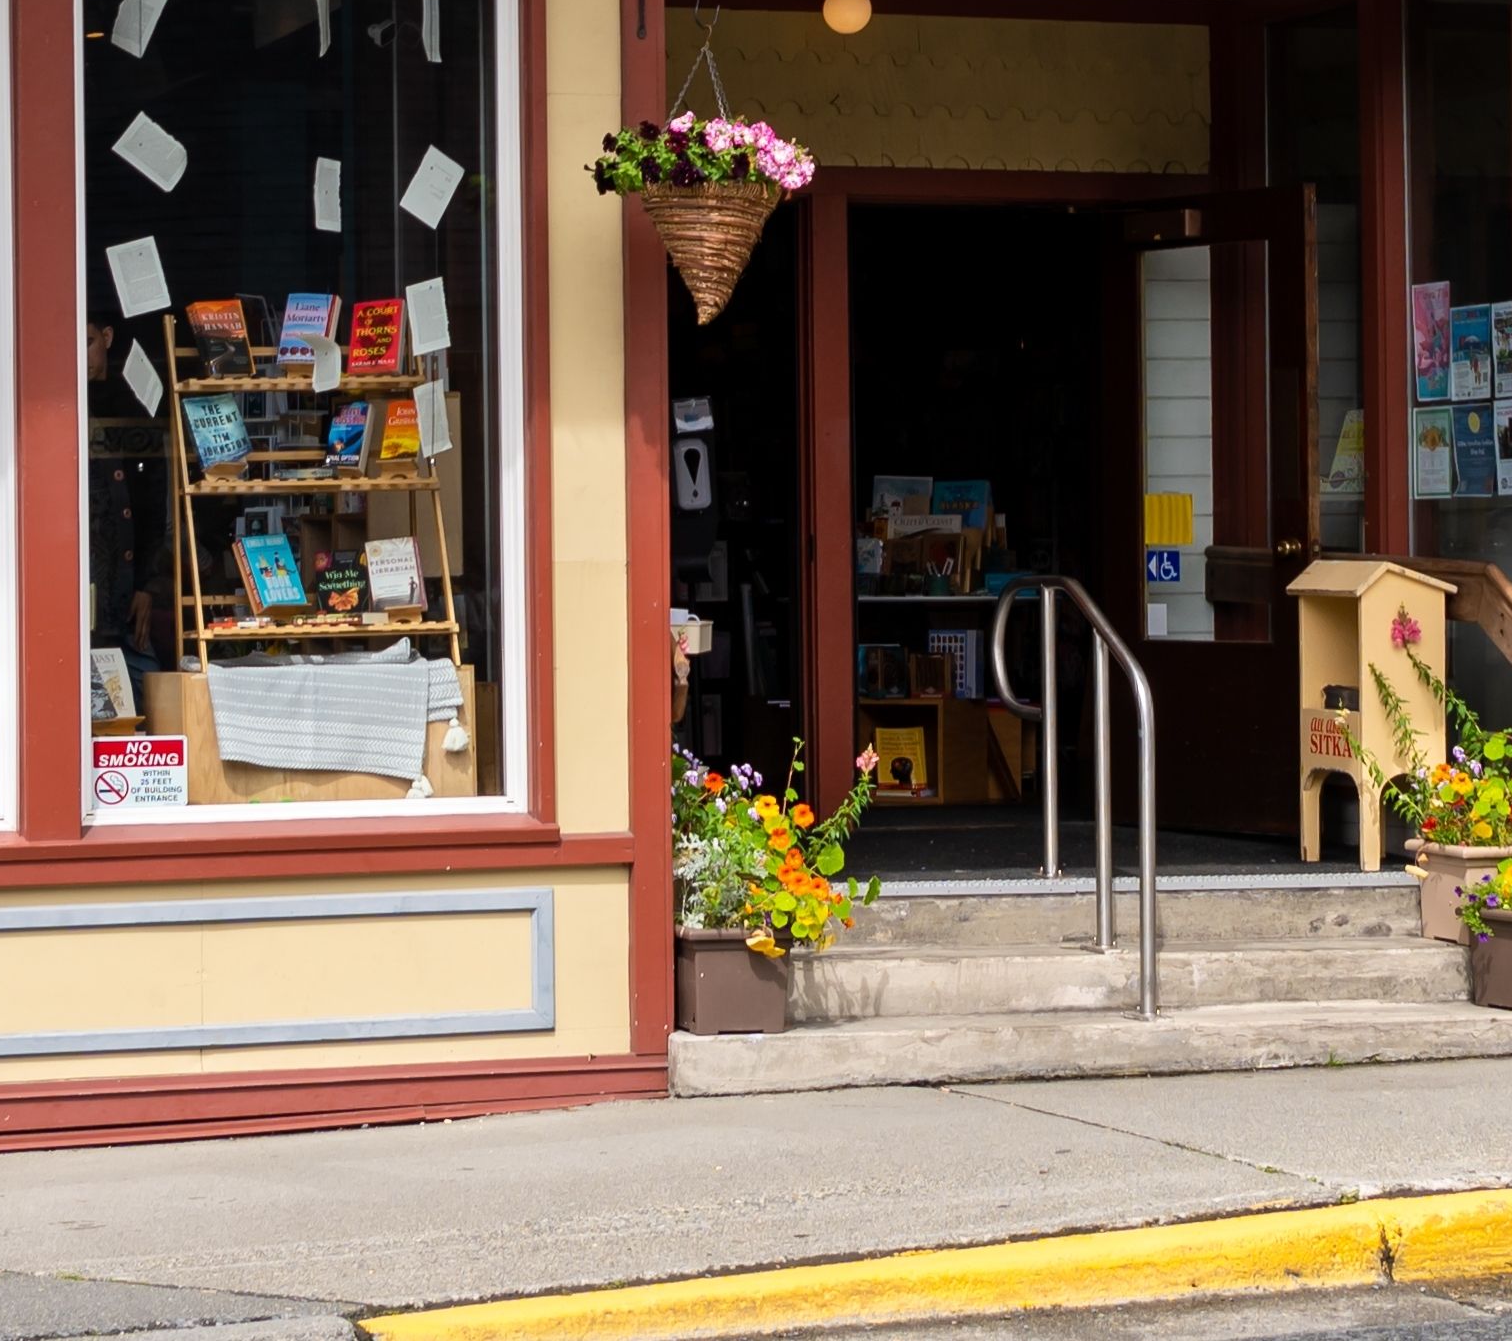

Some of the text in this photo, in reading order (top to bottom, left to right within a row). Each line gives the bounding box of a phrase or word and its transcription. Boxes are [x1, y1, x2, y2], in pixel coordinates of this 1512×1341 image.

[295, 302, 321, 312] Liane
[366, 306, 399, 316] COURT
[202, 312, 240, 321] KRISTIN
[204, 322, 242, 331] HANNAH
[356, 325, 398, 336] THORNS
[353, 346, 386, 357] ROSES
[201, 404, 221, 416] THE
[194, 411, 238, 429] CURRENT
[213, 432, 230, 444] TIM
[203, 438, 248, 457] JOHNSTON
[370, 556, 414, 566] PERSONAL
[371, 565, 415, 575] LIBRARIAN
[126, 741, 152, 754] NO
[1310, 733, 1352, 758] SITKA
[98, 752, 179, 767] SMOKING
[142, 769, 171, 777] WITHIN
[152, 777, 172, 785] FEET
[144, 786, 183, 794] BUILDING
[135, 795, 178, 803] ENTRANCE
